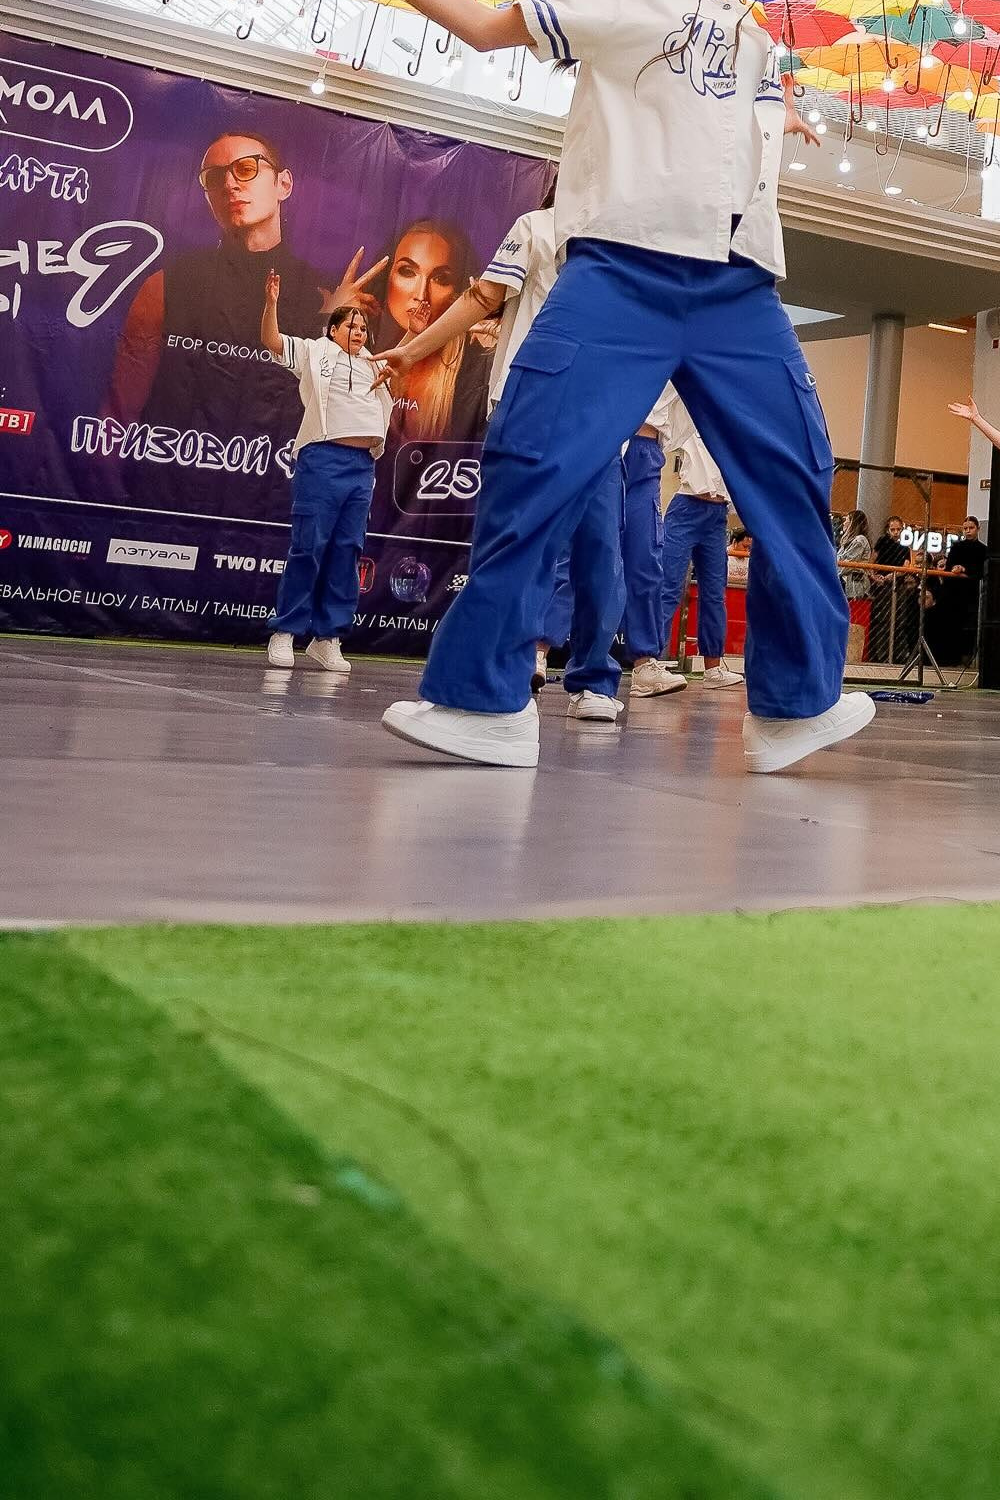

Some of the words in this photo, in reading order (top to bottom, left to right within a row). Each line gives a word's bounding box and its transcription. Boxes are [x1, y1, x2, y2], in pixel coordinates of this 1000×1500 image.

[0, 76, 107, 125] МОЛЛ
[167, 334, 203, 351] ЕГОР
[206, 341, 274, 362] СОКОЛО
[71, 415, 272, 476] ПРИЗОВОЙ
[18, 534, 92, 554] YAMAGUCHI
[213, 554, 256, 572] TWO
[259, 557, 288, 575] KE
[85, 590, 127, 607] ШОУ
[141, 596, 198, 613] БАТТЛЫ
[212, 601, 278, 619] ТАНЦЕВА
[379, 615, 429, 631] БАТТЛЫ
